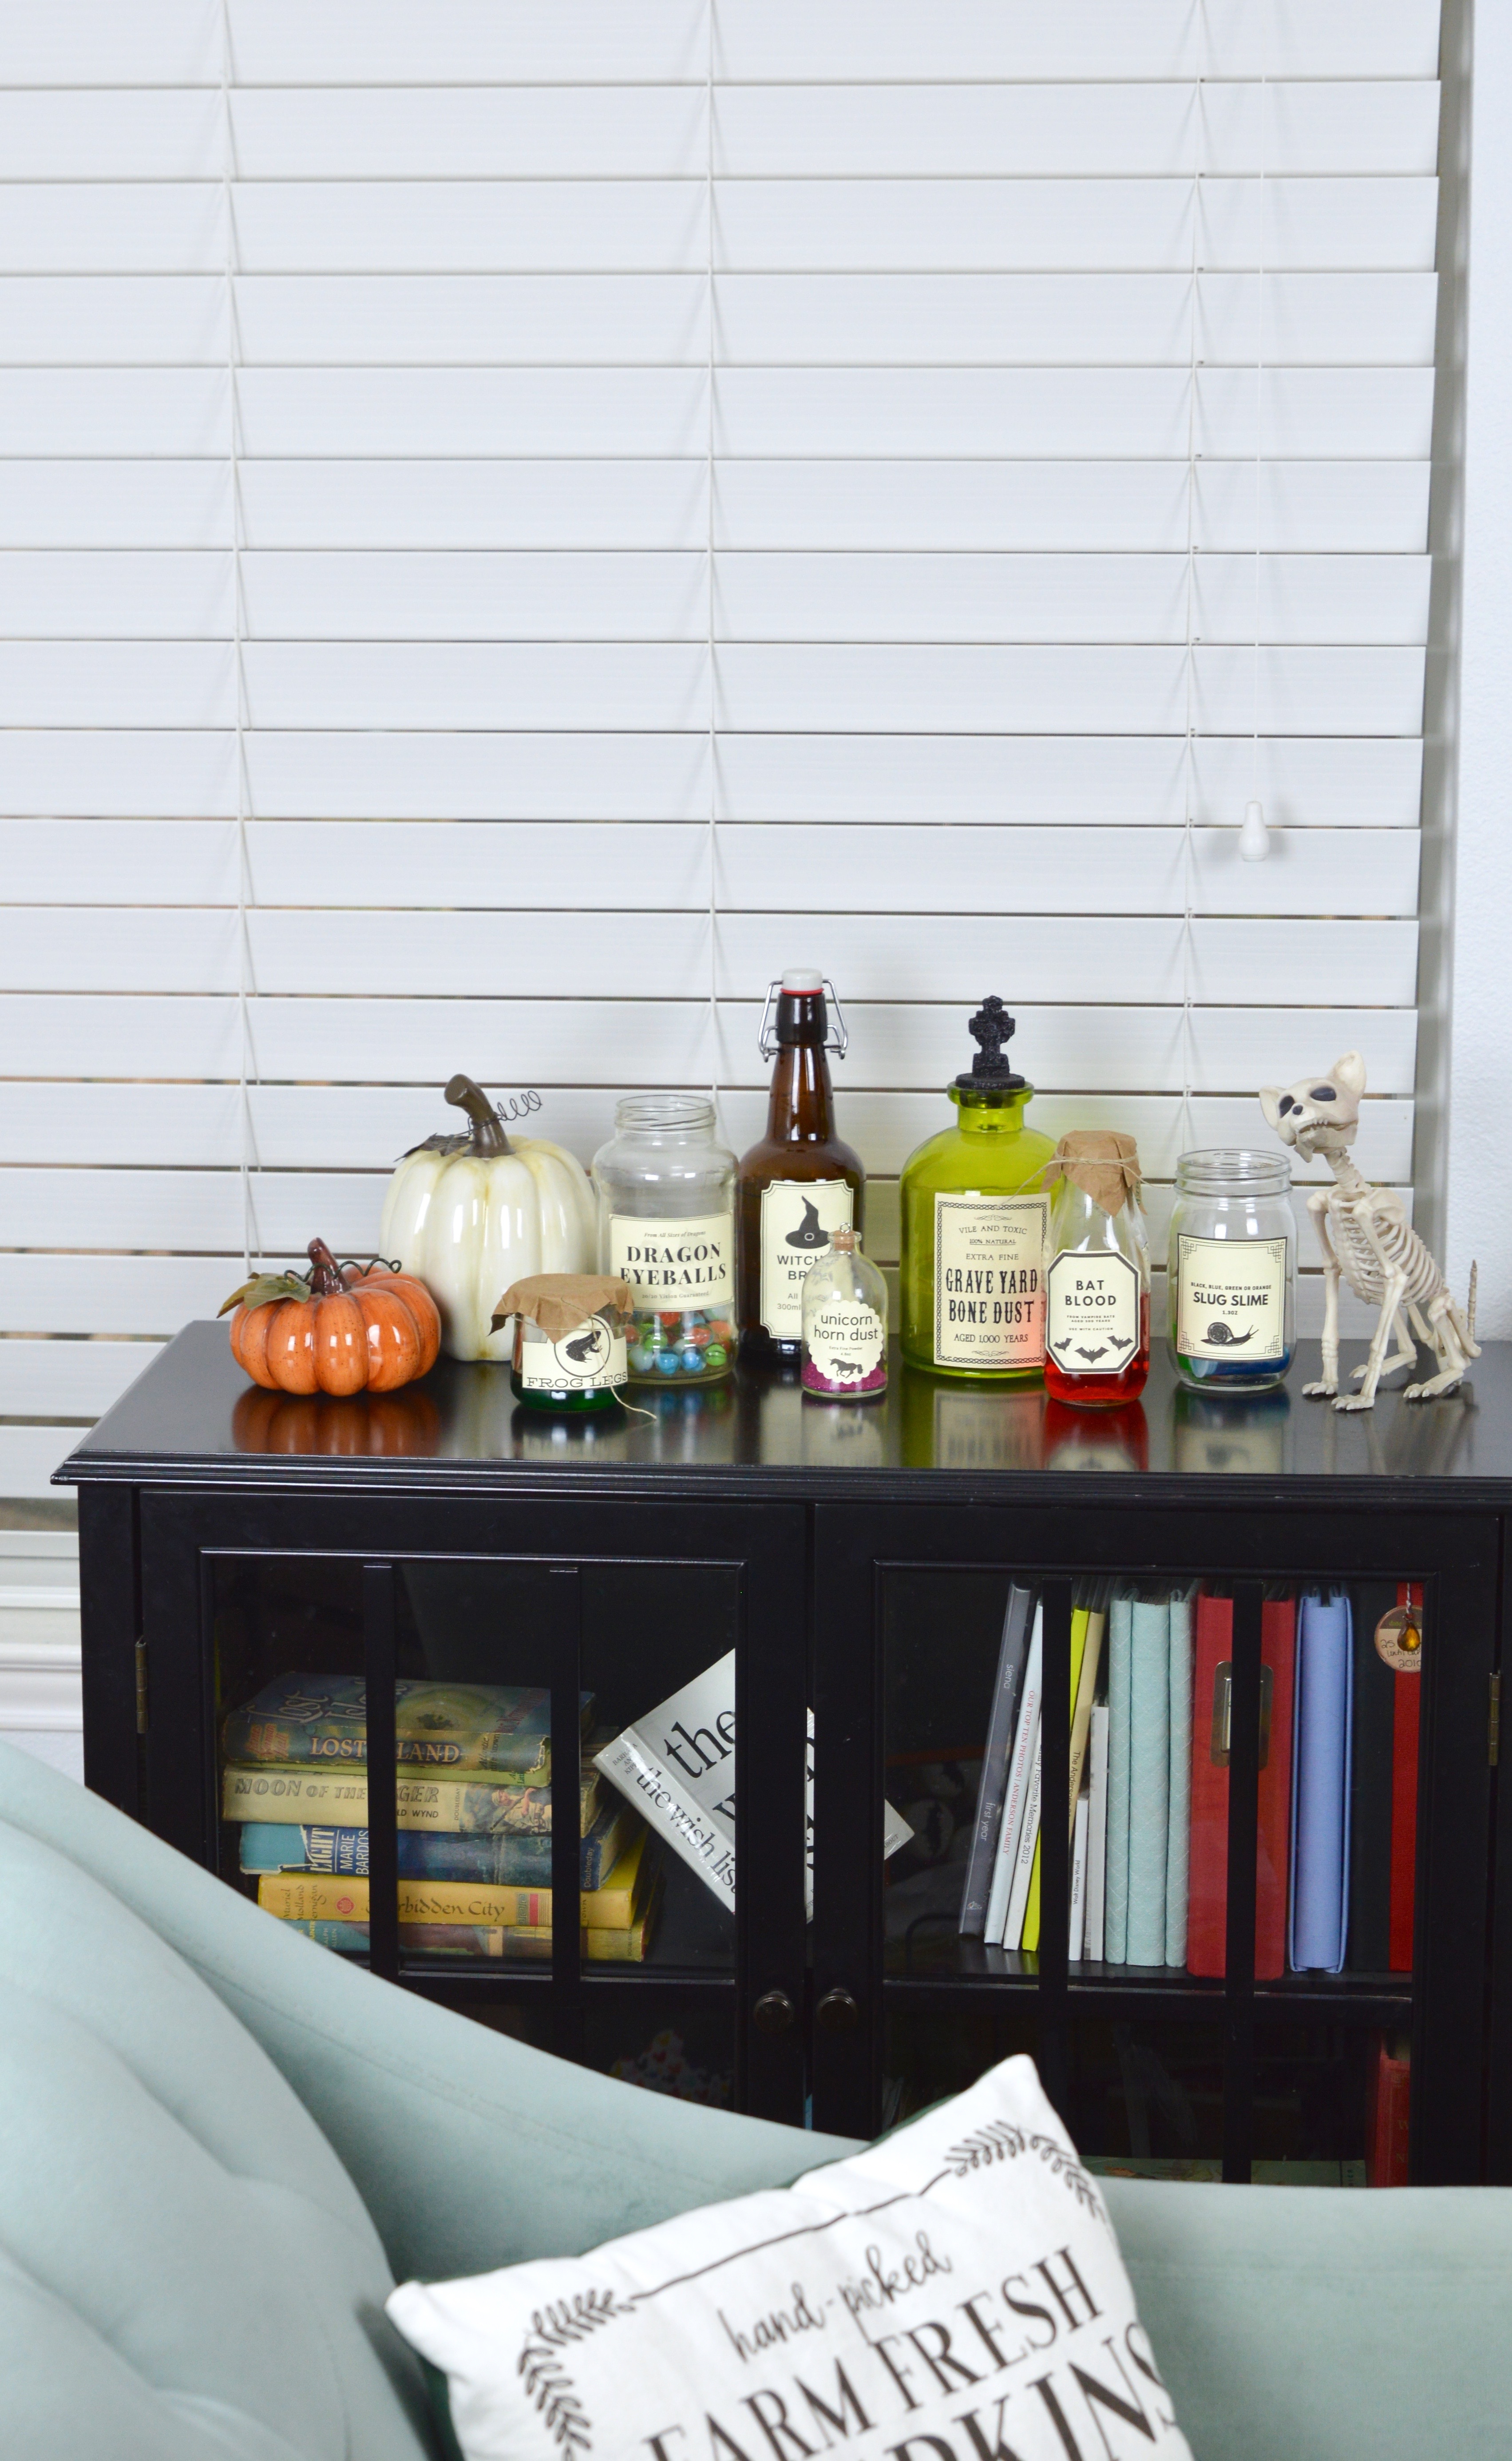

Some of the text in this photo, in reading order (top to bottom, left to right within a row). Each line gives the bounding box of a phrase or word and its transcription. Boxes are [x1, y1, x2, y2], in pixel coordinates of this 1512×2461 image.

[1003, 1226, 1027, 1234] TOXIC
[627, 1242, 721, 1263] DRAGON
[620, 1263, 726, 1285] EYEBALLS
[946, 1268, 1038, 1294] GRAVE YARD
[1076, 1280, 1104, 1290] BAT
[1065, 1295, 1116, 1306] BLOOD
[1193, 1291, 1268, 1306] SLUG SLIME
[821, 1313, 872, 1325] unicorn
[949, 1299, 1035, 1324] BONE DUST
[814, 1325, 879, 1341] horn dust
[954, 1333, 975, 1342] AGED
[1004, 1334, 1029, 1343] YEARS
[526, 1371, 627, 1388] FROG LEGS
[1380, 1639, 1395, 1649] 25
[309, 1737, 460, 1763] LOST LAND
[1072, 1751, 1081, 1765] The
[1002, 1690, 1035, 1855] OUR TOP TEN PHOTOS ANDERSON FAMILY
[234, 1778, 439, 1803] MOON OF THE GER
[412, 1809, 439, 1818] WYND
[1024, 1804, 1037, 1843] Memories
[637, 1767, 671, 1808] the
[670, 1804, 716, 1859] wish
[710, 1850, 736, 1894] lis
[340, 1834, 356, 1870] MARIE
[355, 1830, 369, 1875] BARDOS
[1021, 1844, 1031, 1864] 2012
[584, 1847, 594, 1888] Doubleday
[397, 1896, 504, 1922] rbidden City
[717, 2230, 953, 2363] hand-picked
[873, 2245, 1104, 2413] FRESH
